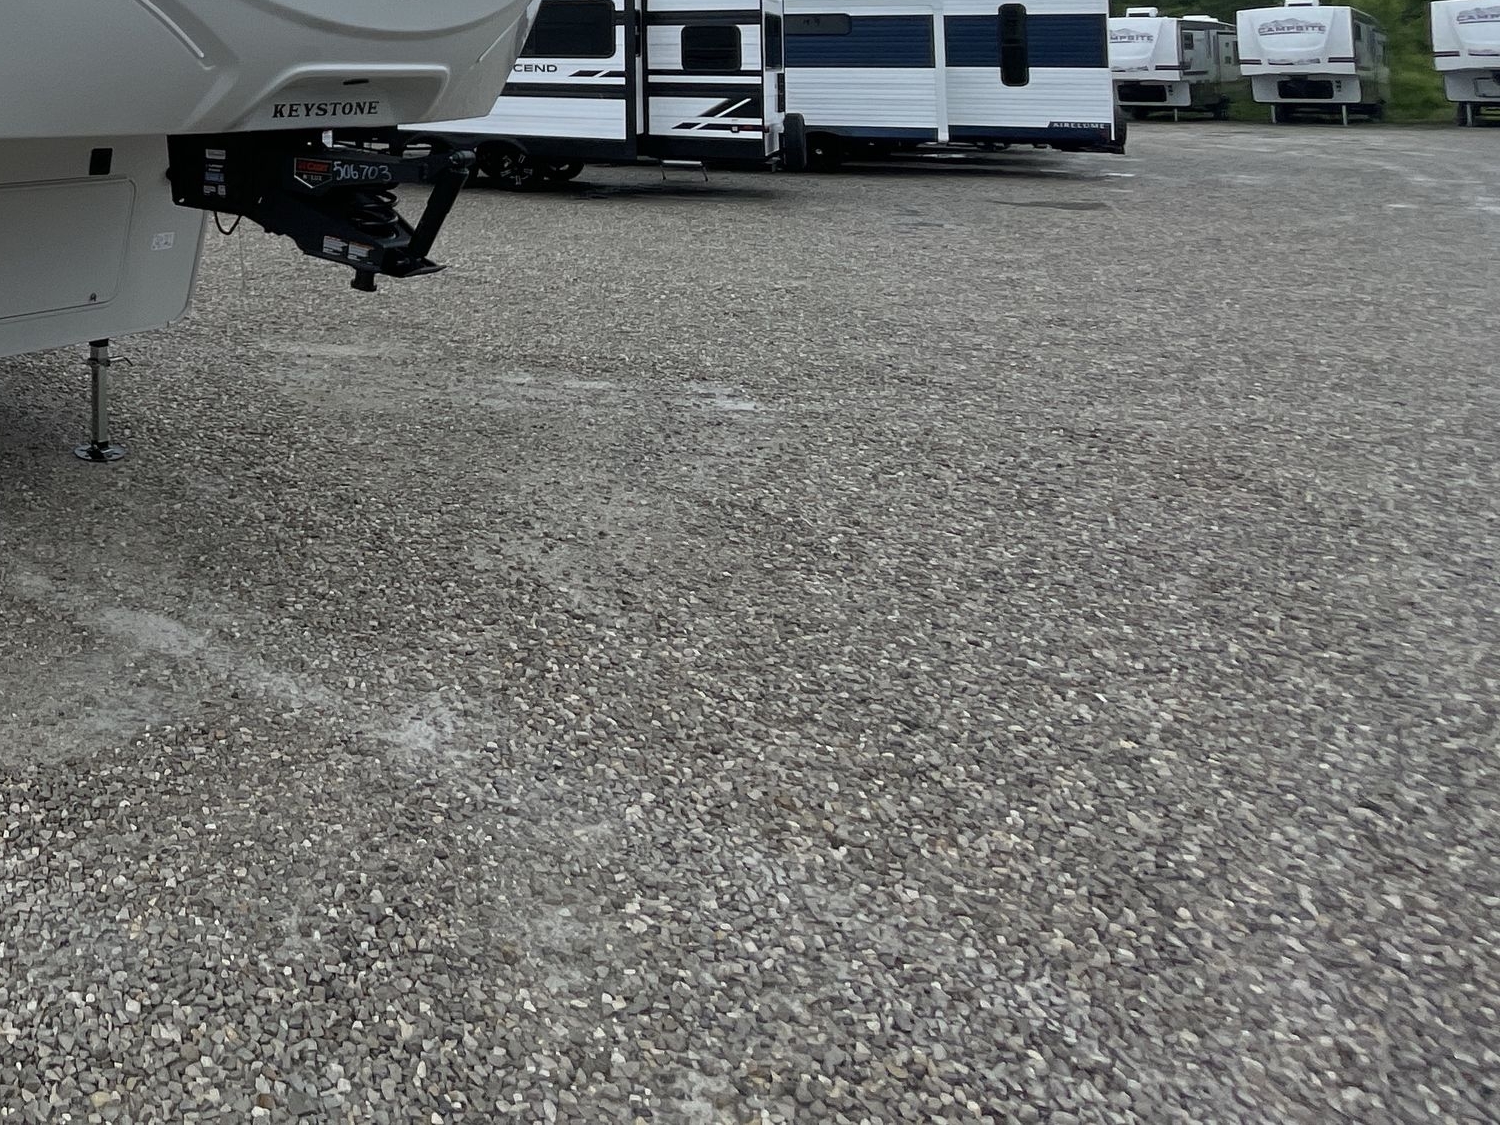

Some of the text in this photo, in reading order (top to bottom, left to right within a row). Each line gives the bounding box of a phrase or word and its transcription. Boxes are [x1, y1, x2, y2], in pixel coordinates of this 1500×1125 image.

[513, 64, 558, 72] CEND
[272, 101, 380, 118] KEYSTONE
[333, 161, 392, 182] 506703
